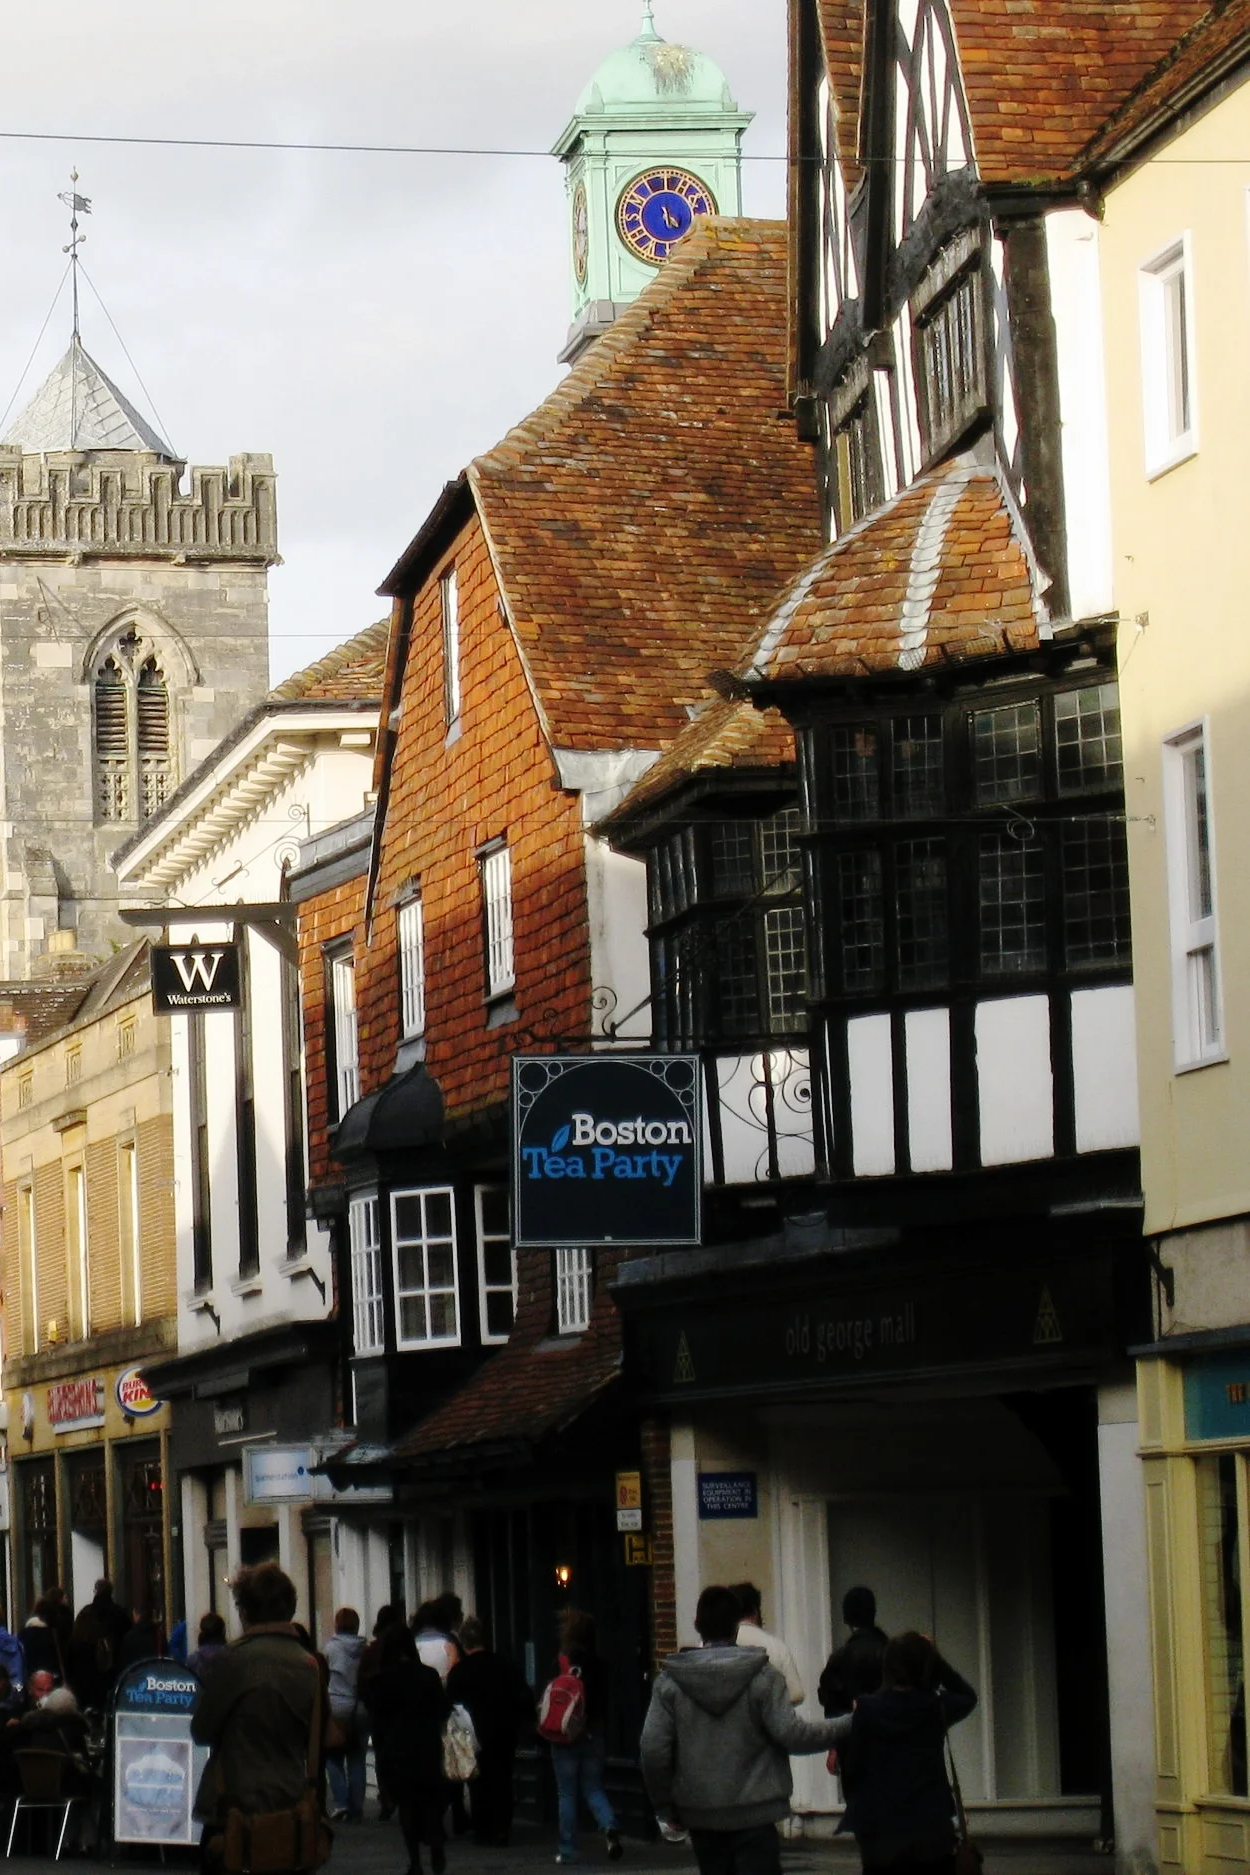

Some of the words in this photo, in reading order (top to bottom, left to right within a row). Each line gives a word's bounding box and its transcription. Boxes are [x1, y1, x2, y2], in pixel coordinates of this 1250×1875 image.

[170, 953, 224, 992] W
[167, 993, 231, 1005] Waterstone's
[571, 1113, 692, 1146] Boston
[522, 1147, 587, 1180] Tea
[590, 1147, 683, 1187] Party
[786, 1314, 810, 1356] old
[816, 1318, 873, 1363] george
[880, 1300, 916, 1346] mall
[122, 1380, 143, 1392] BUR
[123, 1388, 152, 1404] KIN
[146, 1676, 196, 1693] Boston
[126, 1689, 152, 1704] Tea
[156, 1691, 195, 1707] Party
